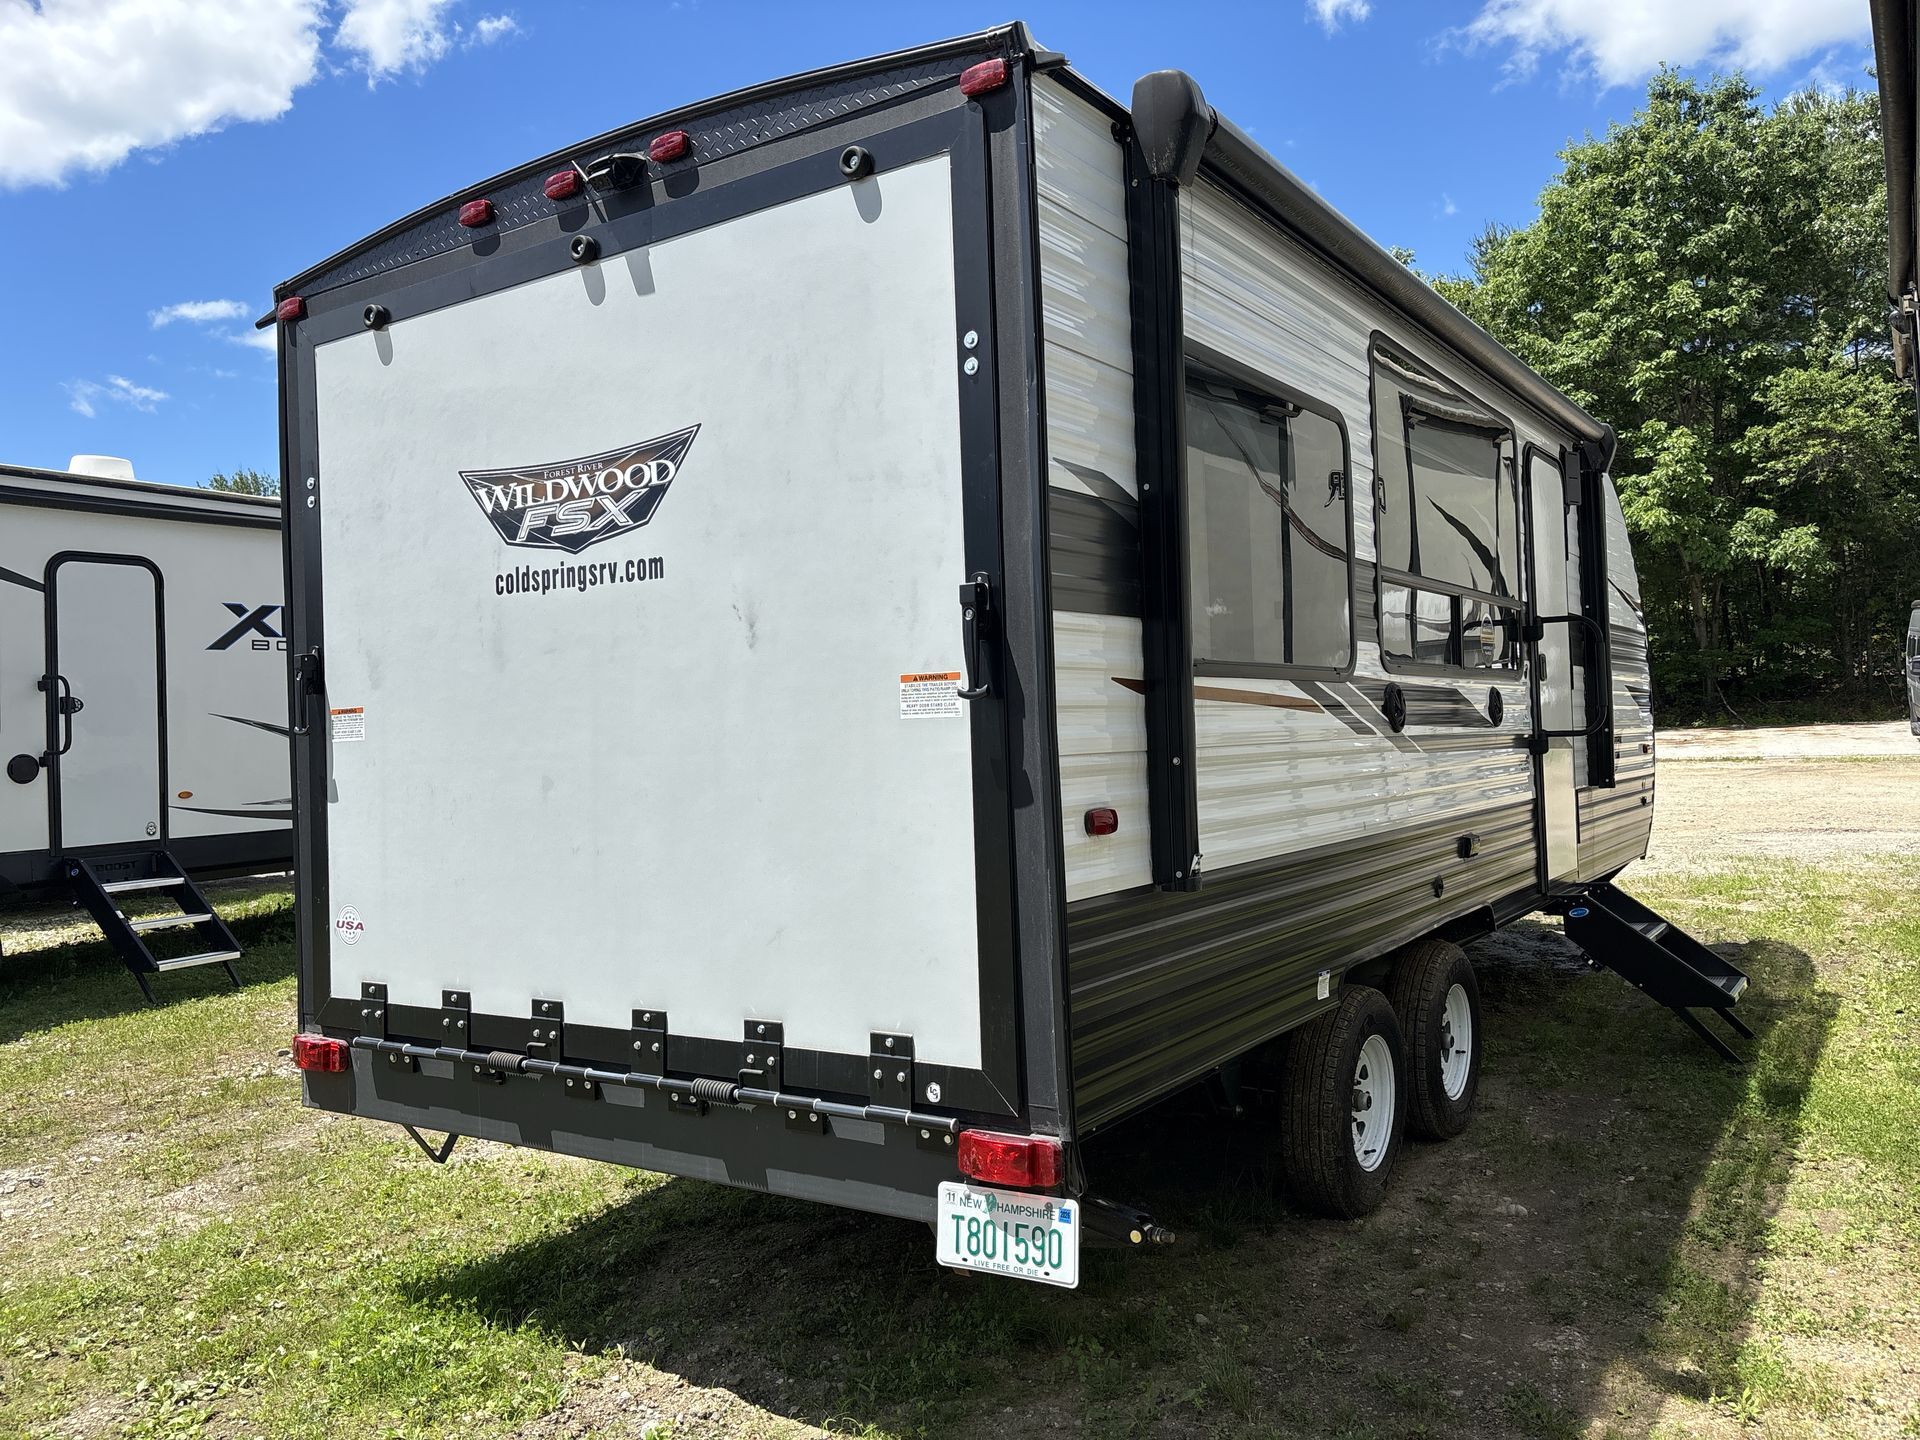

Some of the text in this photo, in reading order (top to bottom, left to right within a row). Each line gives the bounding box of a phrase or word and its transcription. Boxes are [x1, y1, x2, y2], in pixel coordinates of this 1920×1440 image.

[543, 461, 604, 479] FOREST RIVER
[476, 459, 676, 514] WILDWOOD
[516, 488, 650, 542] FSX
[495, 555, 665, 596] coldspringsrv.com
[918, 673, 948, 681] WARNING
[336, 920, 364, 931] USA
[946, 1192, 956, 1203] 11
[959, 1196, 1056, 1221] NEW HAMPSHIRE
[951, 1213, 1063, 1270] T801590
[973, 1259, 989, 1268] LIVE
[992, 1262, 1010, 1272] FREE
[1027, 1268, 1039, 1276] DIE
